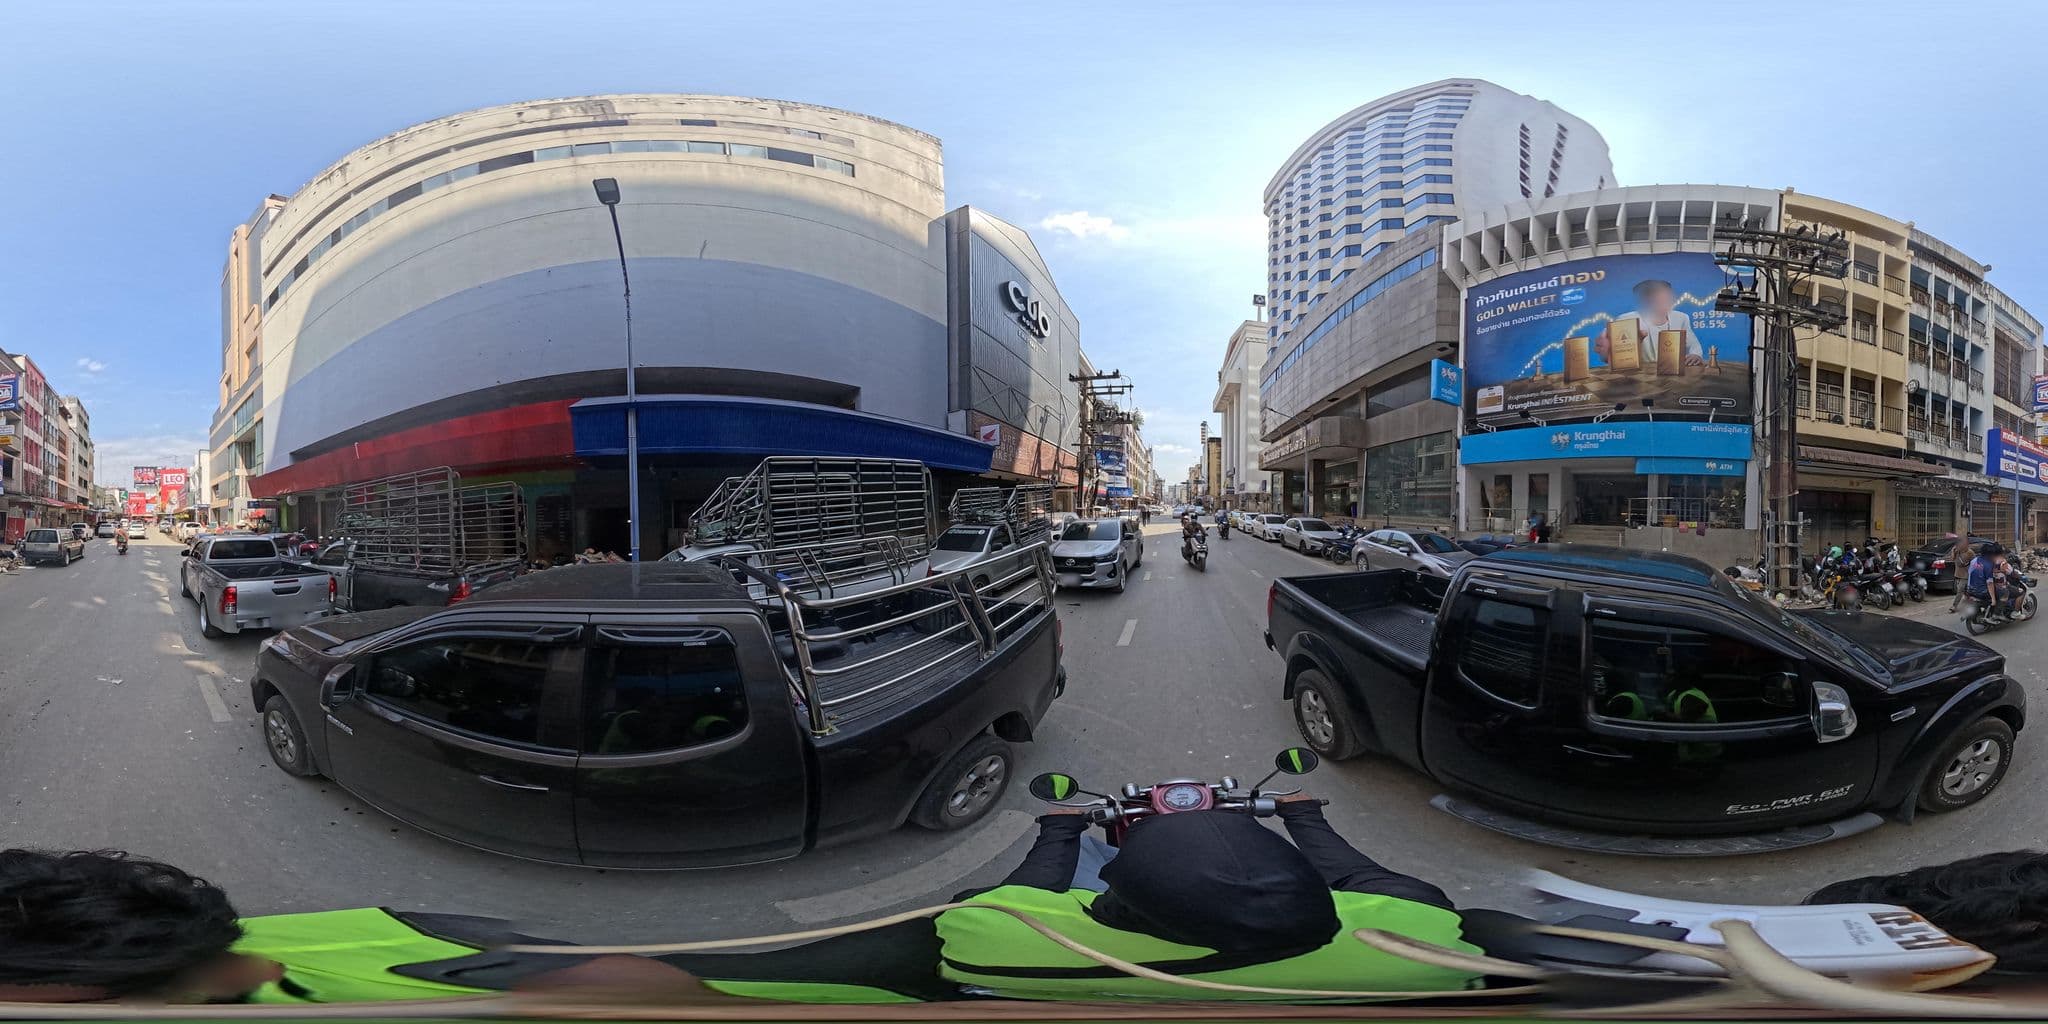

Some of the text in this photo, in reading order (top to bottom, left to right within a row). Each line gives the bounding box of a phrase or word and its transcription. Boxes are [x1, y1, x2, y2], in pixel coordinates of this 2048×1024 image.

[1476, 294, 1556, 322] GOLD WALLET
[1692, 320, 1727, 329] 96.5%
[1507, 400, 1540, 410] Krungthai
[1574, 430, 1625, 442] Krungthai
[165, 475, 183, 483] LEO
